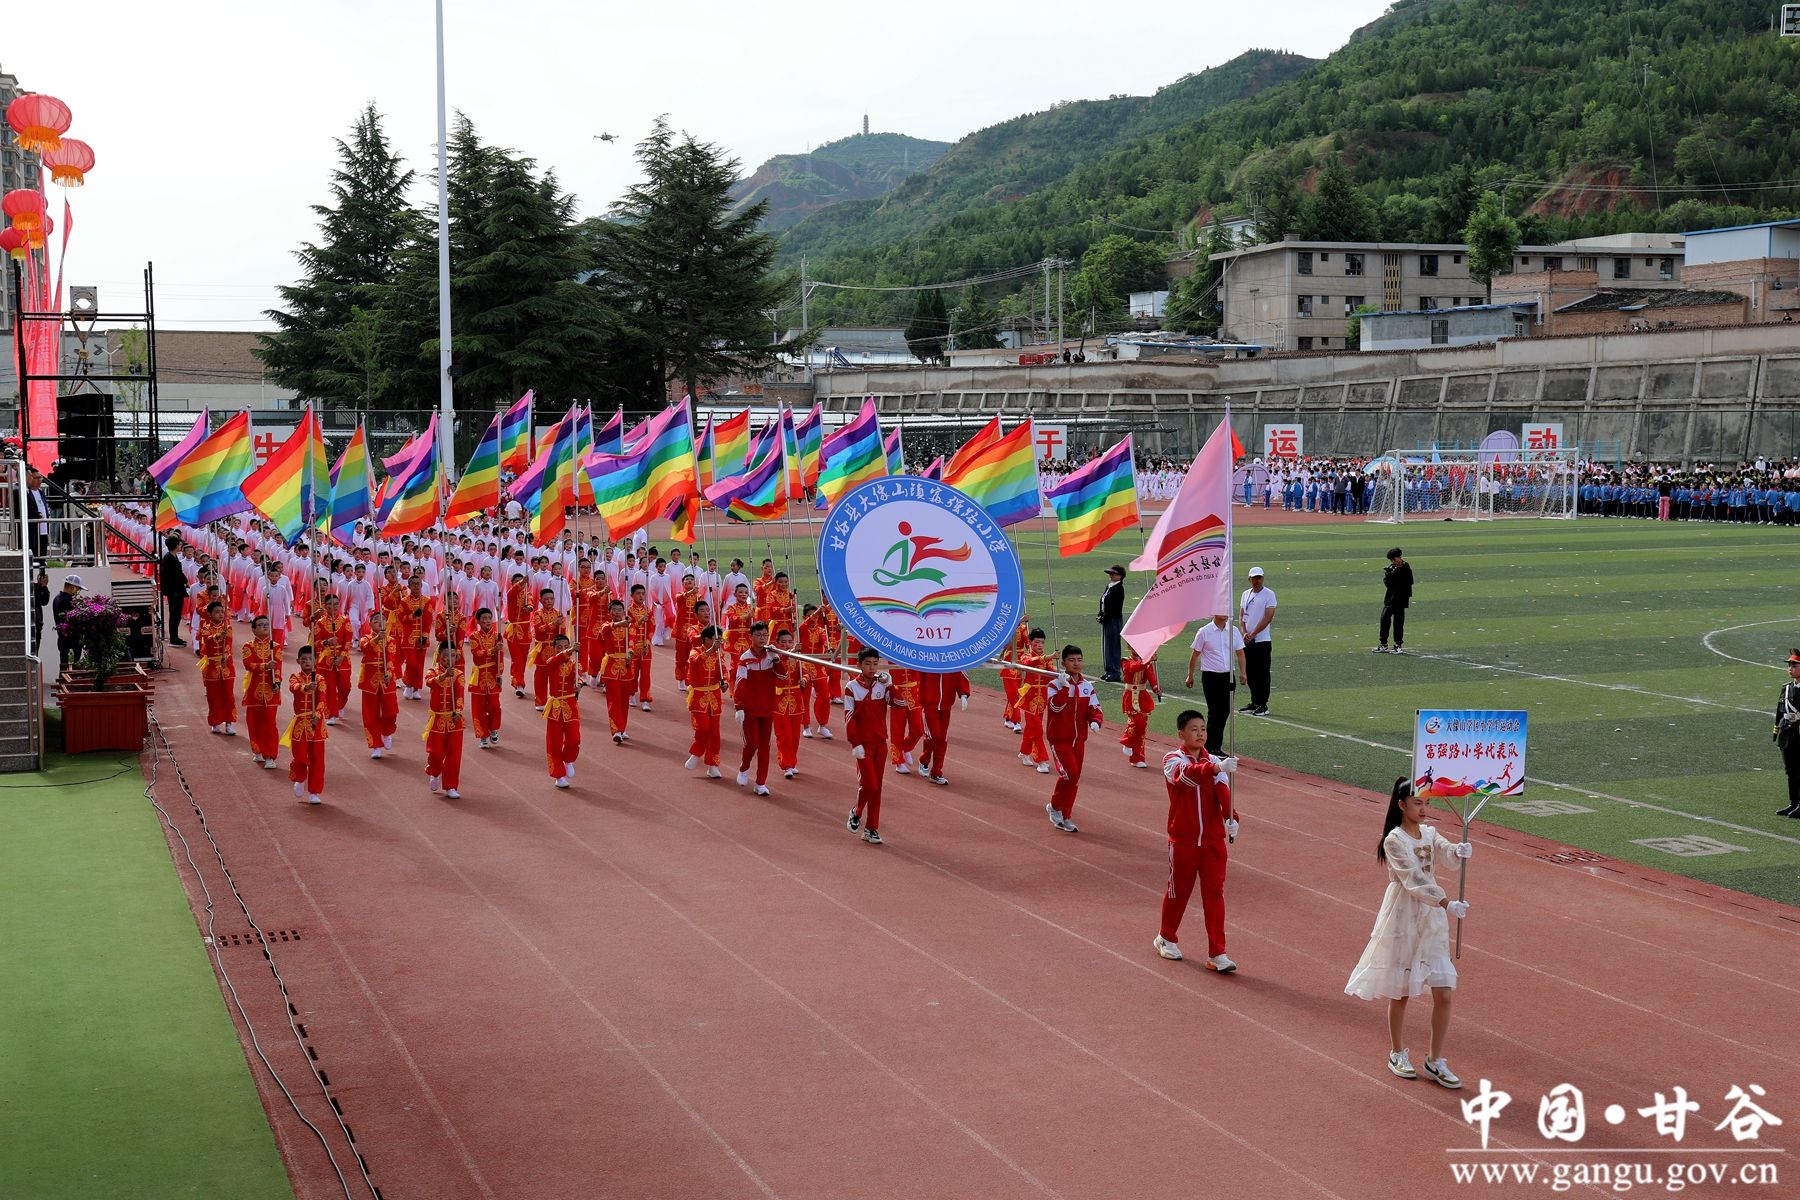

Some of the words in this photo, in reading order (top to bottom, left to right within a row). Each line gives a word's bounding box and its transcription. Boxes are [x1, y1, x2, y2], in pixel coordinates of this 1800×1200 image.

[1036, 430, 1063, 459] 于
[1269, 429, 1298, 457] 运
[1527, 427, 1557, 457] 动
[844, 601, 858, 618] GAN
[855, 616, 868, 628] GU
[864, 625, 883, 642] XIAN
[881, 637, 893, 649] DA
[893, 642, 917, 659] XIANG
[918, 650, 939, 662] SHAN
[940, 652, 961, 662] ZHEN
[960, 648, 970, 658] FU
[969, 636, 991, 655] QIANG
[986, 631, 998, 641] LU
[993, 616, 1007, 634] XIAO
[1000, 602, 1012, 618] XUE
[915, 627, 952, 640] 2017
[1424, 742, 1519, 760] 富强路小学代表队
